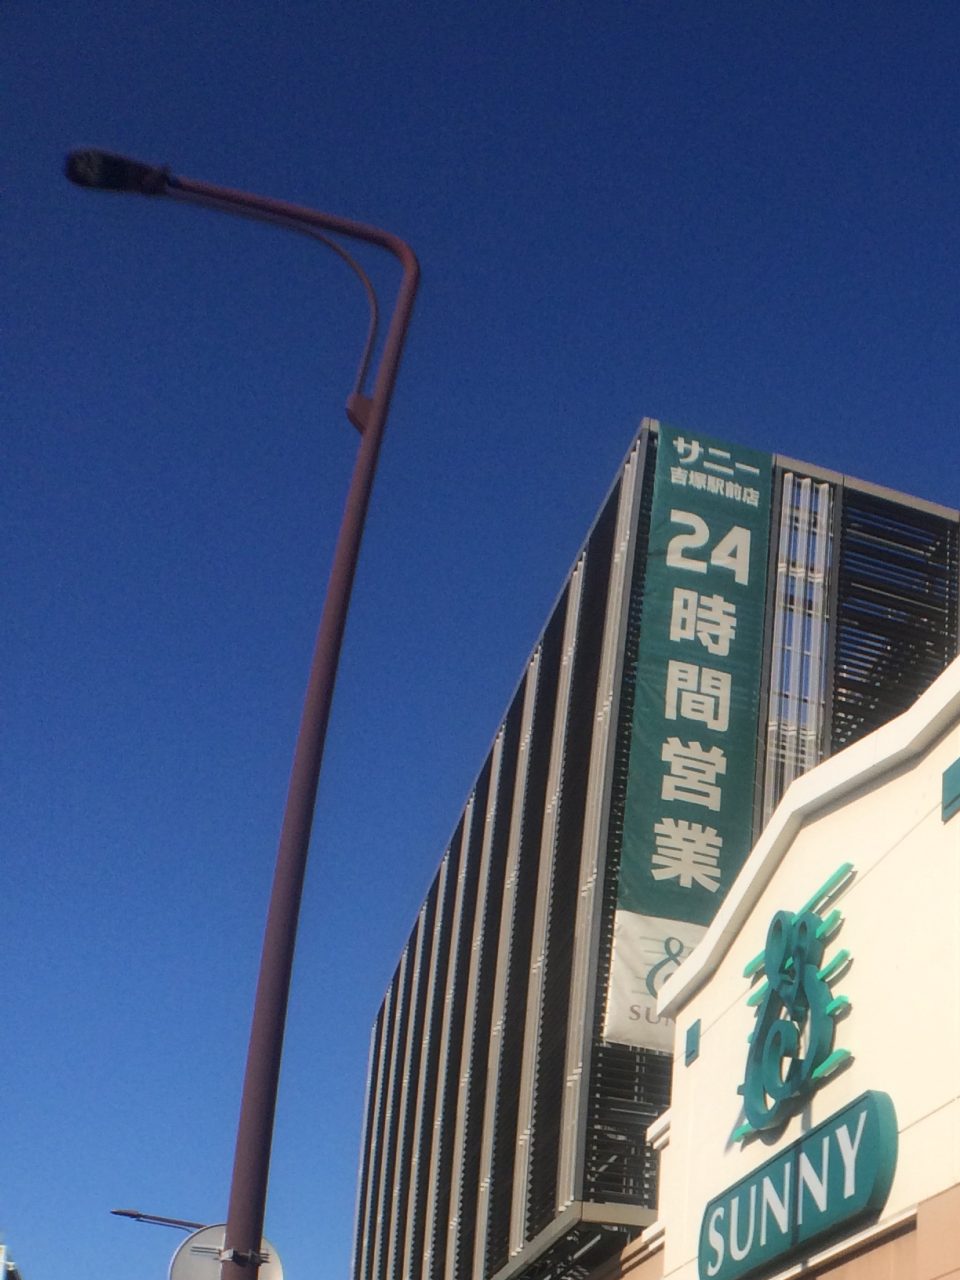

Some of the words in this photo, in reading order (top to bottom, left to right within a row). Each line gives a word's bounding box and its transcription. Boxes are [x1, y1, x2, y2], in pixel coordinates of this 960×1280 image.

[672, 436, 760, 476] サニー
[651, 508, 751, 893] 24時間営業
[706, 1110, 868, 1278] SUNNY
